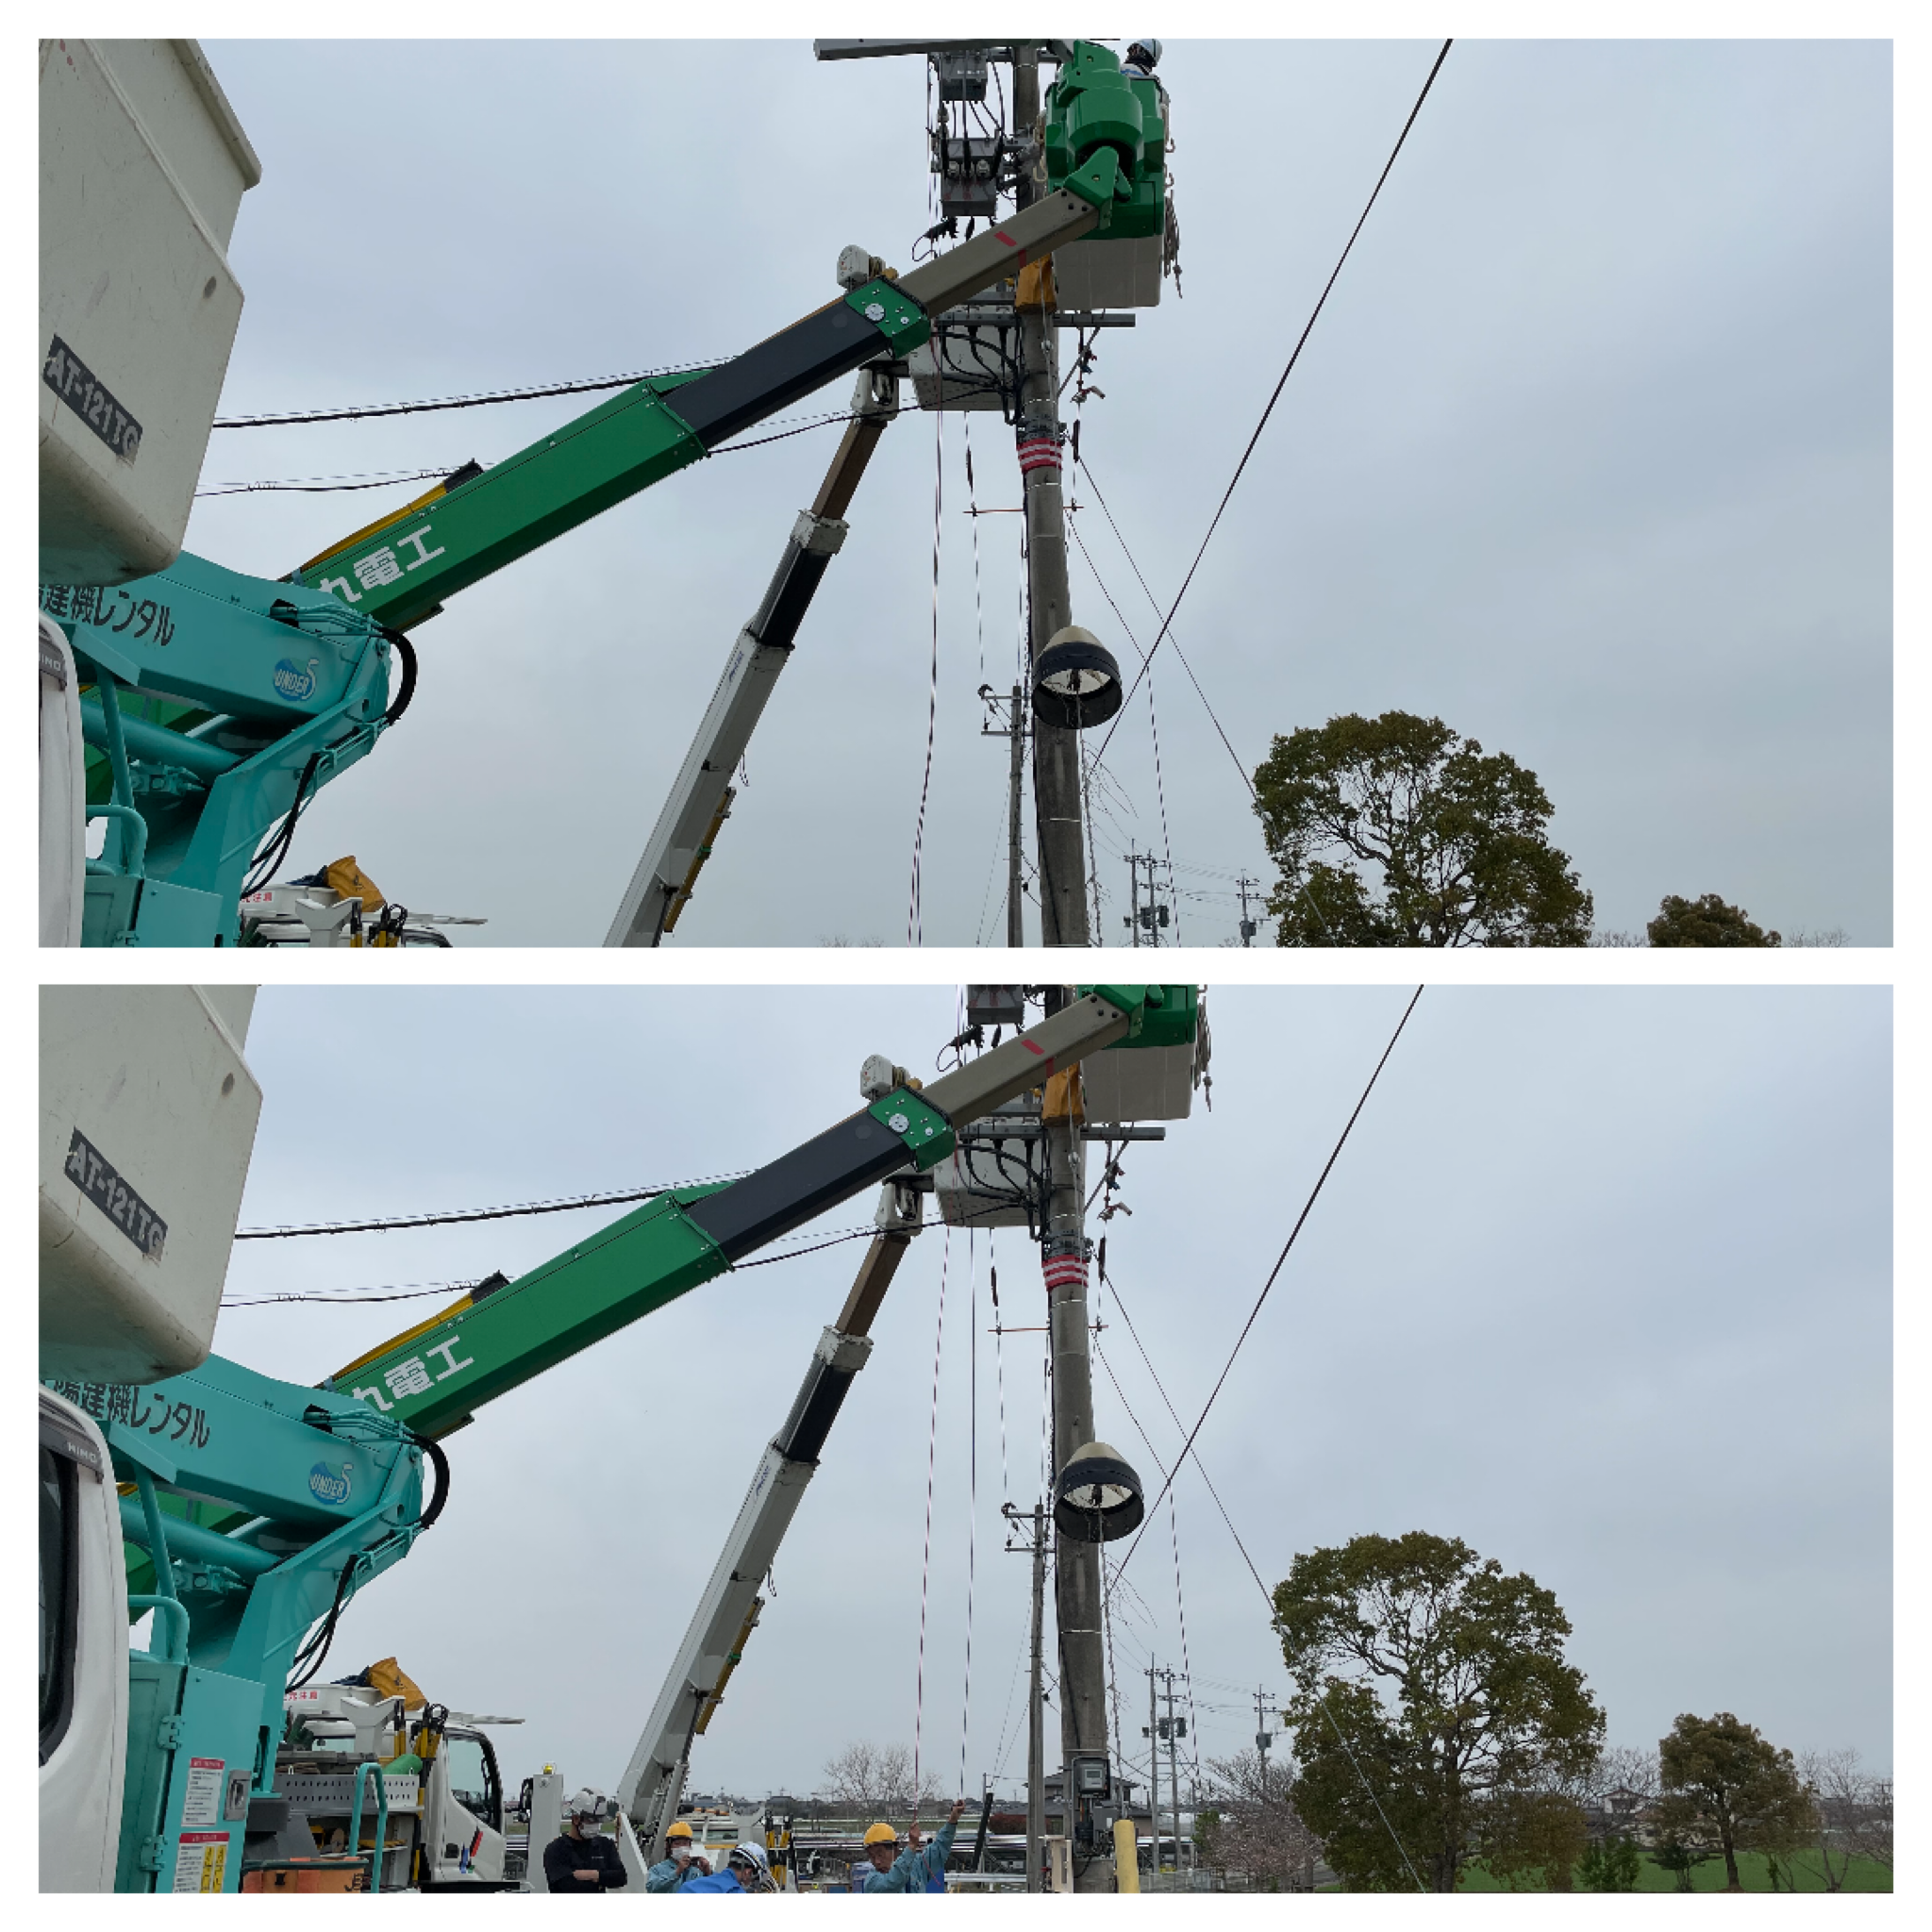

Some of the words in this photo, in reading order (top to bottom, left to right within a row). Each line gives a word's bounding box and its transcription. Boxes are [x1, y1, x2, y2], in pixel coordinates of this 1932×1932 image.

[46, 347, 139, 457] AT-121TG
[39, 584, 175, 646] 建機レンタル
[275, 668, 309, 695] UNDER
[68, 1141, 164, 1253] AT-121TG
[68, 1441, 97, 1463] HINO
[310, 1474, 344, 1498] UNDER
